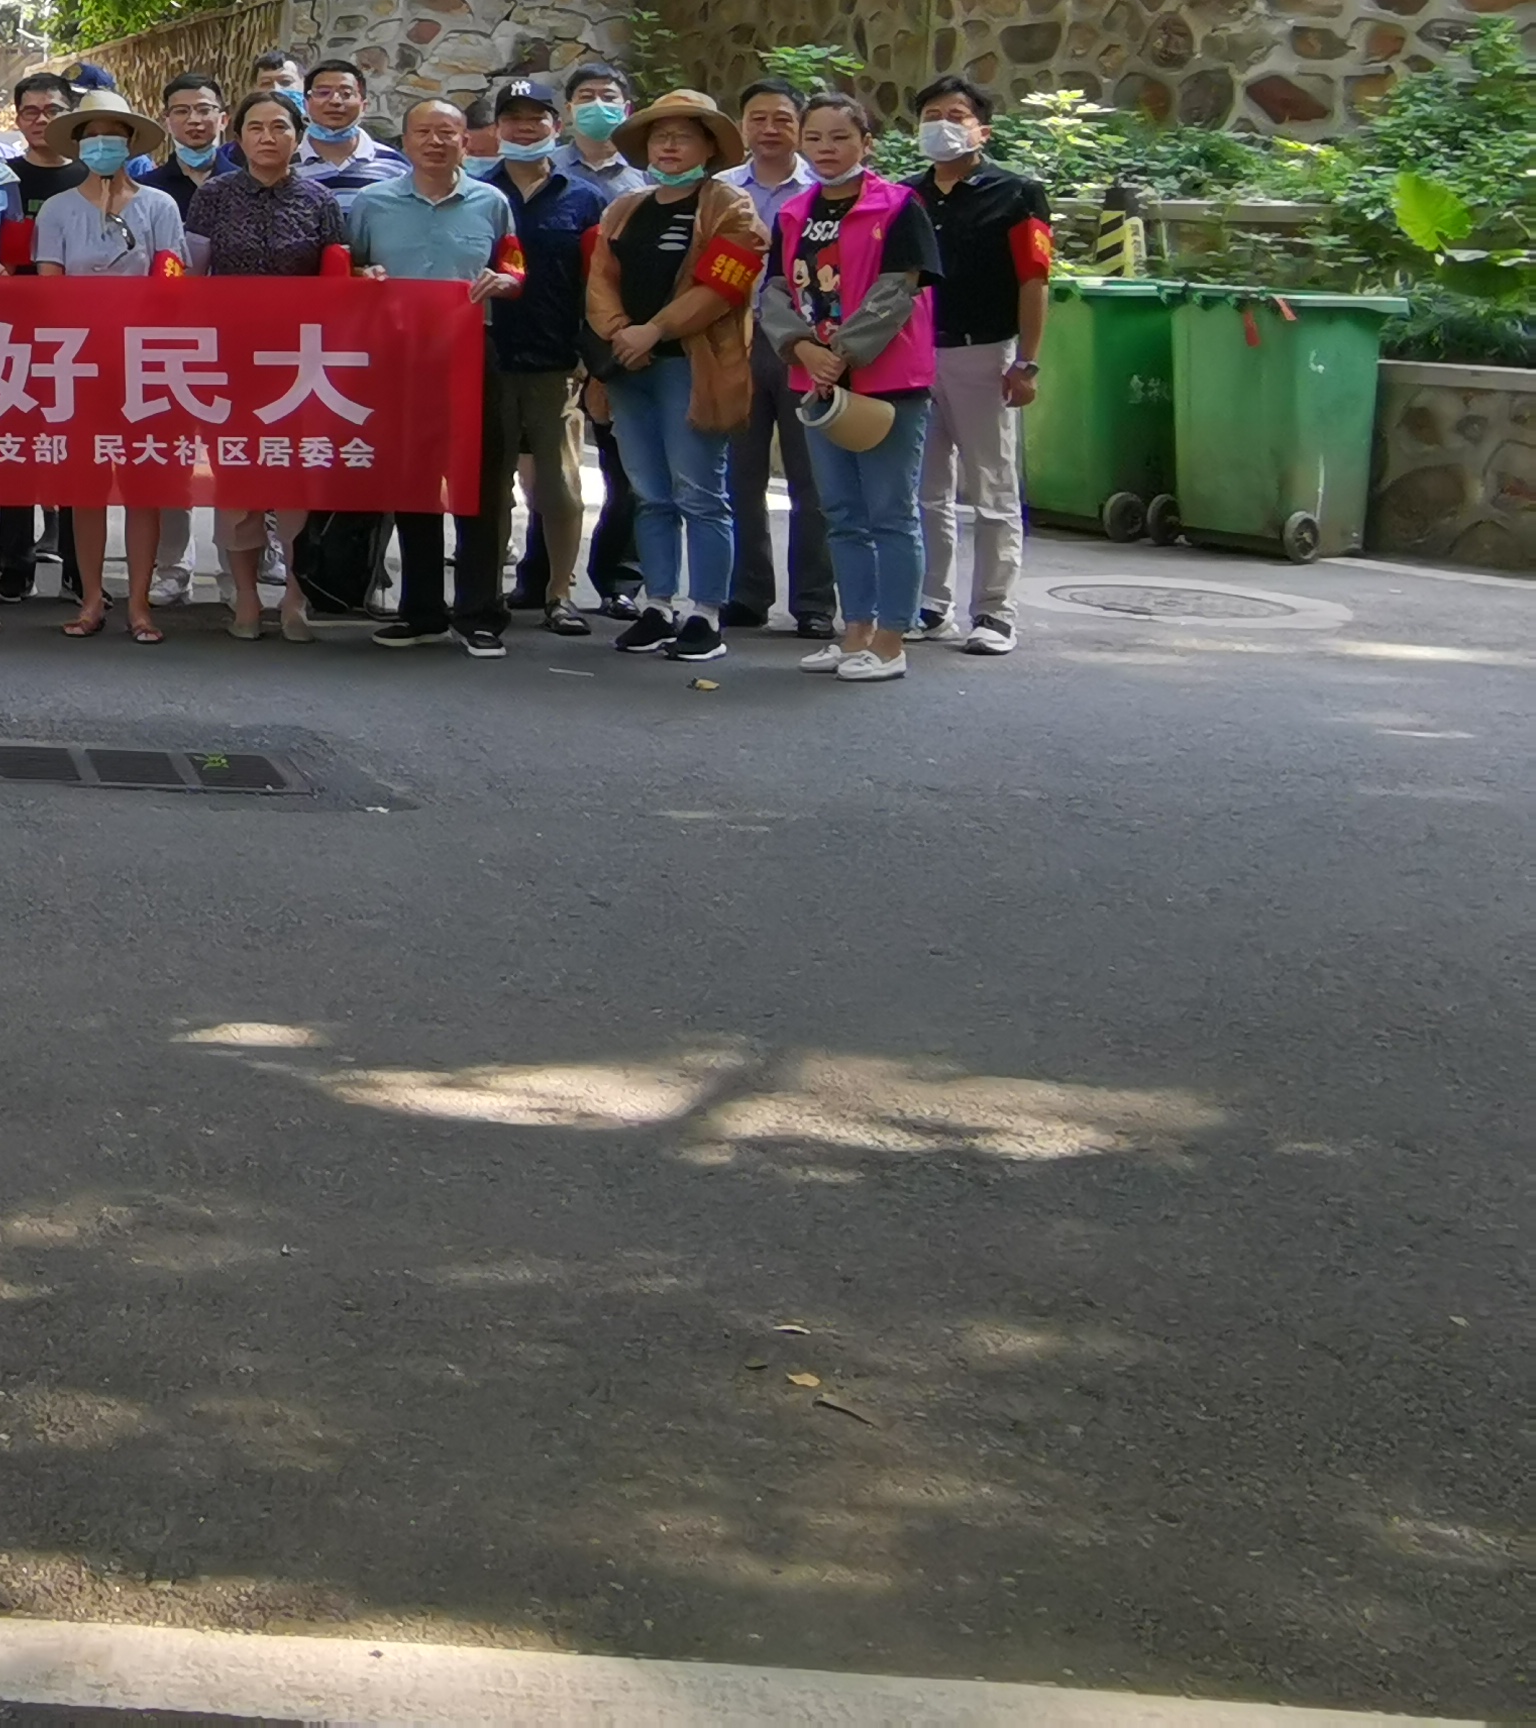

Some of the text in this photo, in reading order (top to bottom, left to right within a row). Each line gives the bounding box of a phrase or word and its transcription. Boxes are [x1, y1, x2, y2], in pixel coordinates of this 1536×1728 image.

[93, 434, 375, 468] 民大社区居委会
